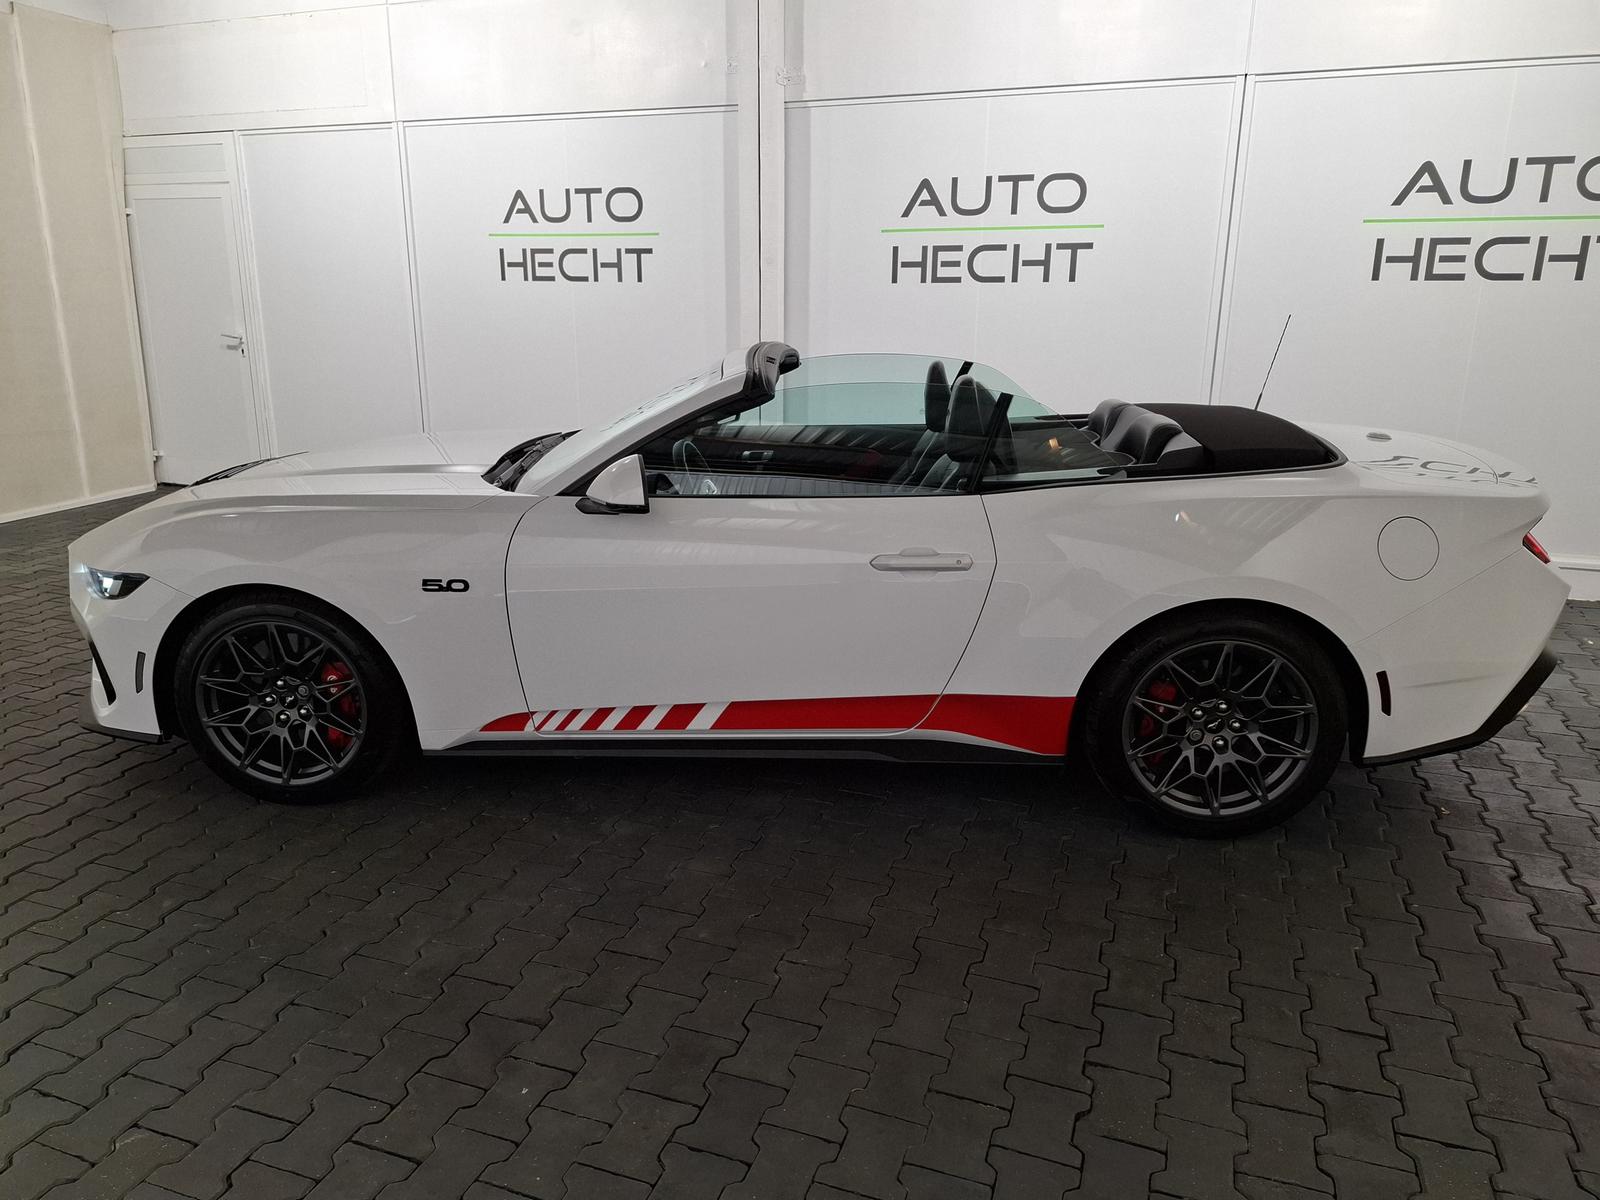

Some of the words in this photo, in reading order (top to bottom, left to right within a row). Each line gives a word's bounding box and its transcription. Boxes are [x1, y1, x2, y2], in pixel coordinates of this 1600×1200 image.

[503, 187, 643, 223] AUTO
[900, 173, 1087, 217] AUTO
[500, 247, 653, 283] HECHT
[892, 242, 1094, 283] HECHT
[1371, 235, 1600, 281] HECH
[421, 578, 470, 593] 5.0
